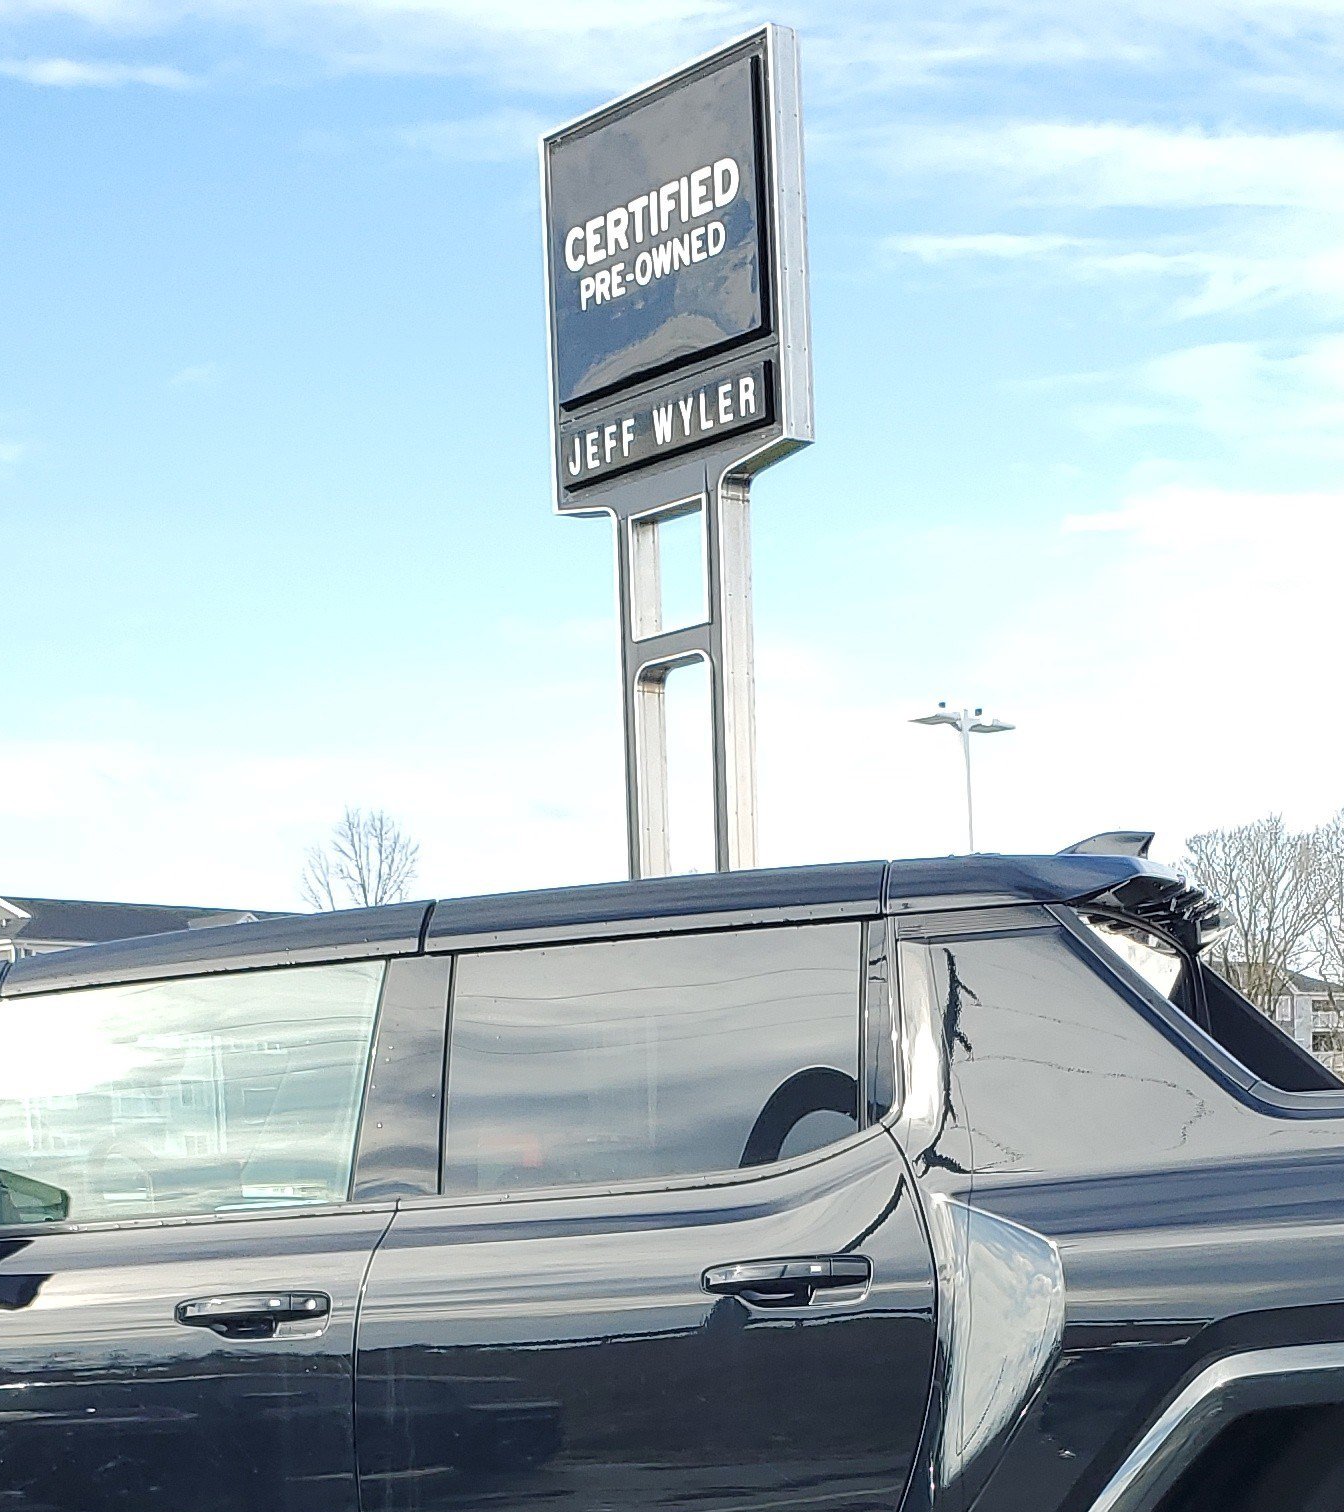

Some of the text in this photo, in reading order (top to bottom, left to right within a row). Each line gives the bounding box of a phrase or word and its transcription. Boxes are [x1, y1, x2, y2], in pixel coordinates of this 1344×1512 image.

[564, 156, 740, 273] CERTIFIED
[580, 221, 726, 311] PRE-OWNED
[568, 376, 756, 477] JEFF WYLER
